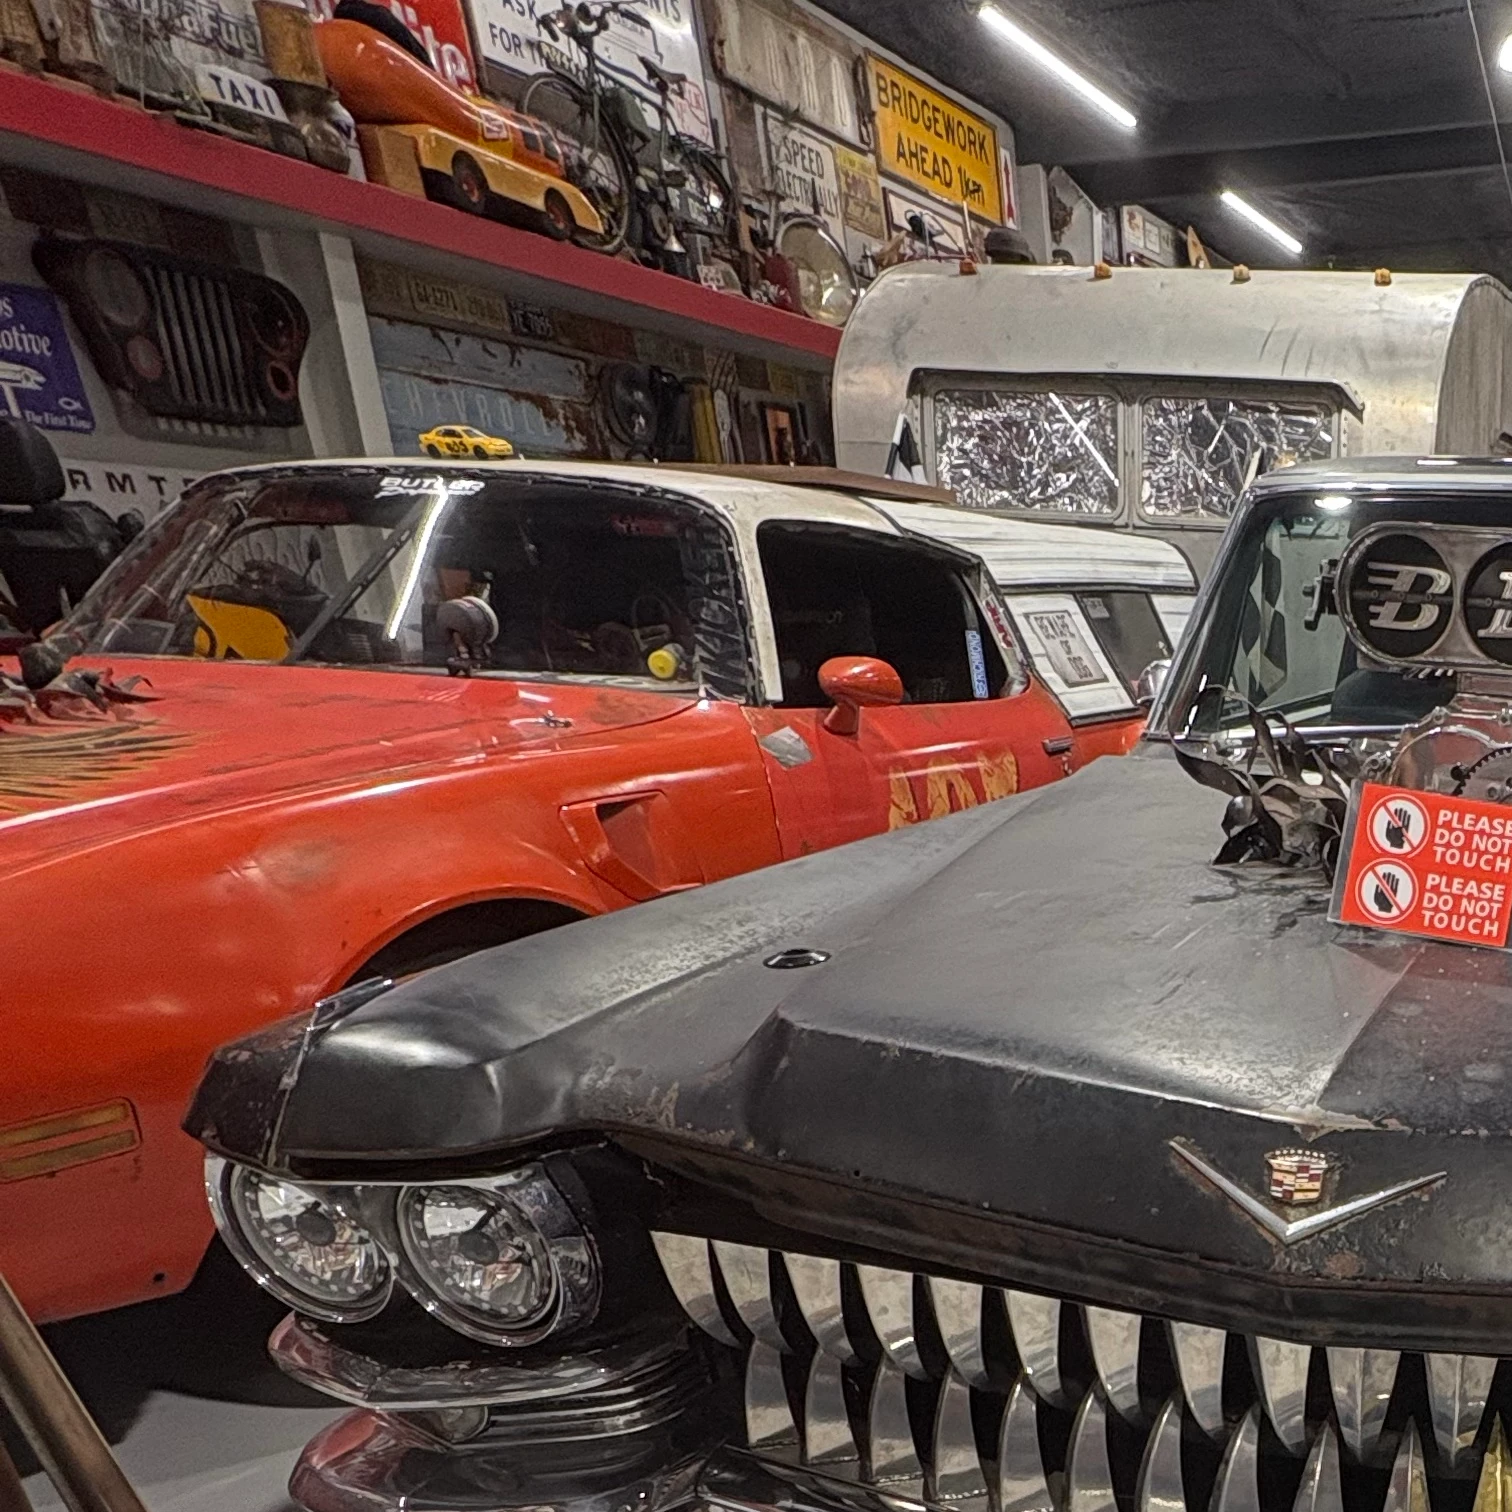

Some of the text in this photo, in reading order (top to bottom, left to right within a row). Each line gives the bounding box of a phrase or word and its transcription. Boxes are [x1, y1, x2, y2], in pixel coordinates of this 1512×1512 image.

[489, 21, 525, 59] FOR
[209, 72, 275, 116] TAXI
[876, 71, 989, 165] BRIDGEWORK
[782, 136, 825, 179] SPEED
[896, 134, 953, 189] AHEAD
[0, 324, 52, 356] otive
[1433, 828, 1465, 847] DO
[1433, 846, 1512, 874] TOUCH
[1425, 873, 1506, 902] PLEASE
[1421, 892, 1503, 919] DO NOT
[1421, 910, 1500, 938] TOUCH
